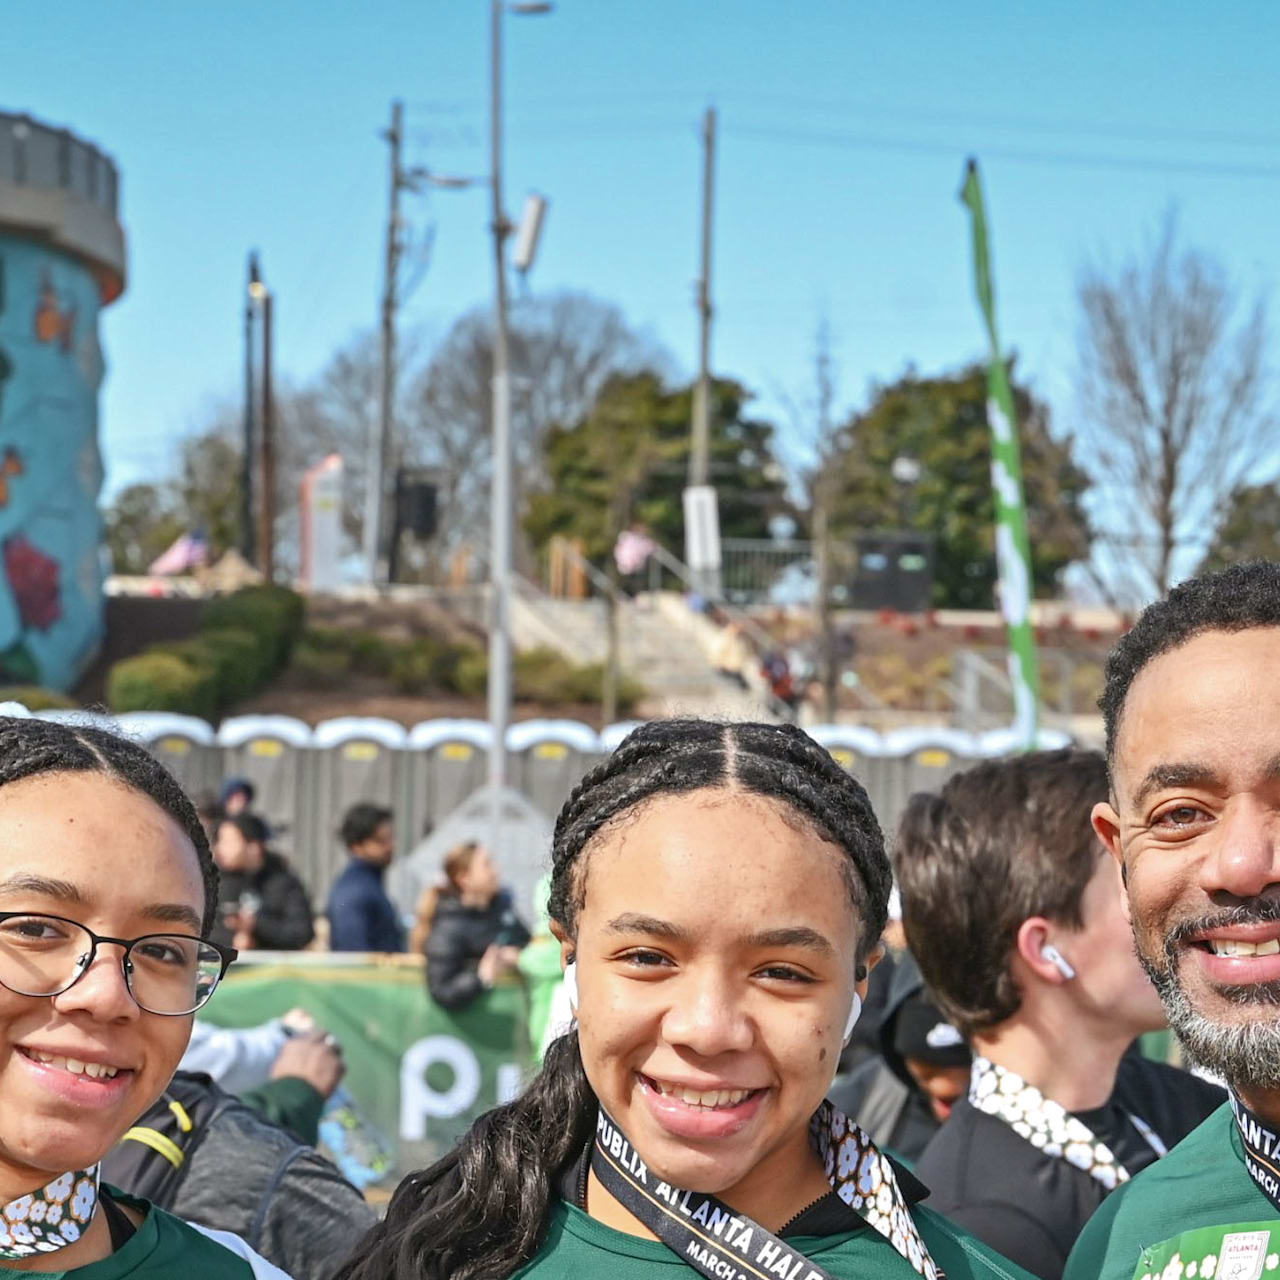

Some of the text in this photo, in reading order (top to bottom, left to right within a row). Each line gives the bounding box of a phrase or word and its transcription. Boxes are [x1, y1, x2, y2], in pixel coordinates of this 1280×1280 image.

[597, 1110, 648, 1184] PUBLIX
[655, 1181, 755, 1253] ATLANTA
[1245, 1154, 1278, 1197] MARCH
